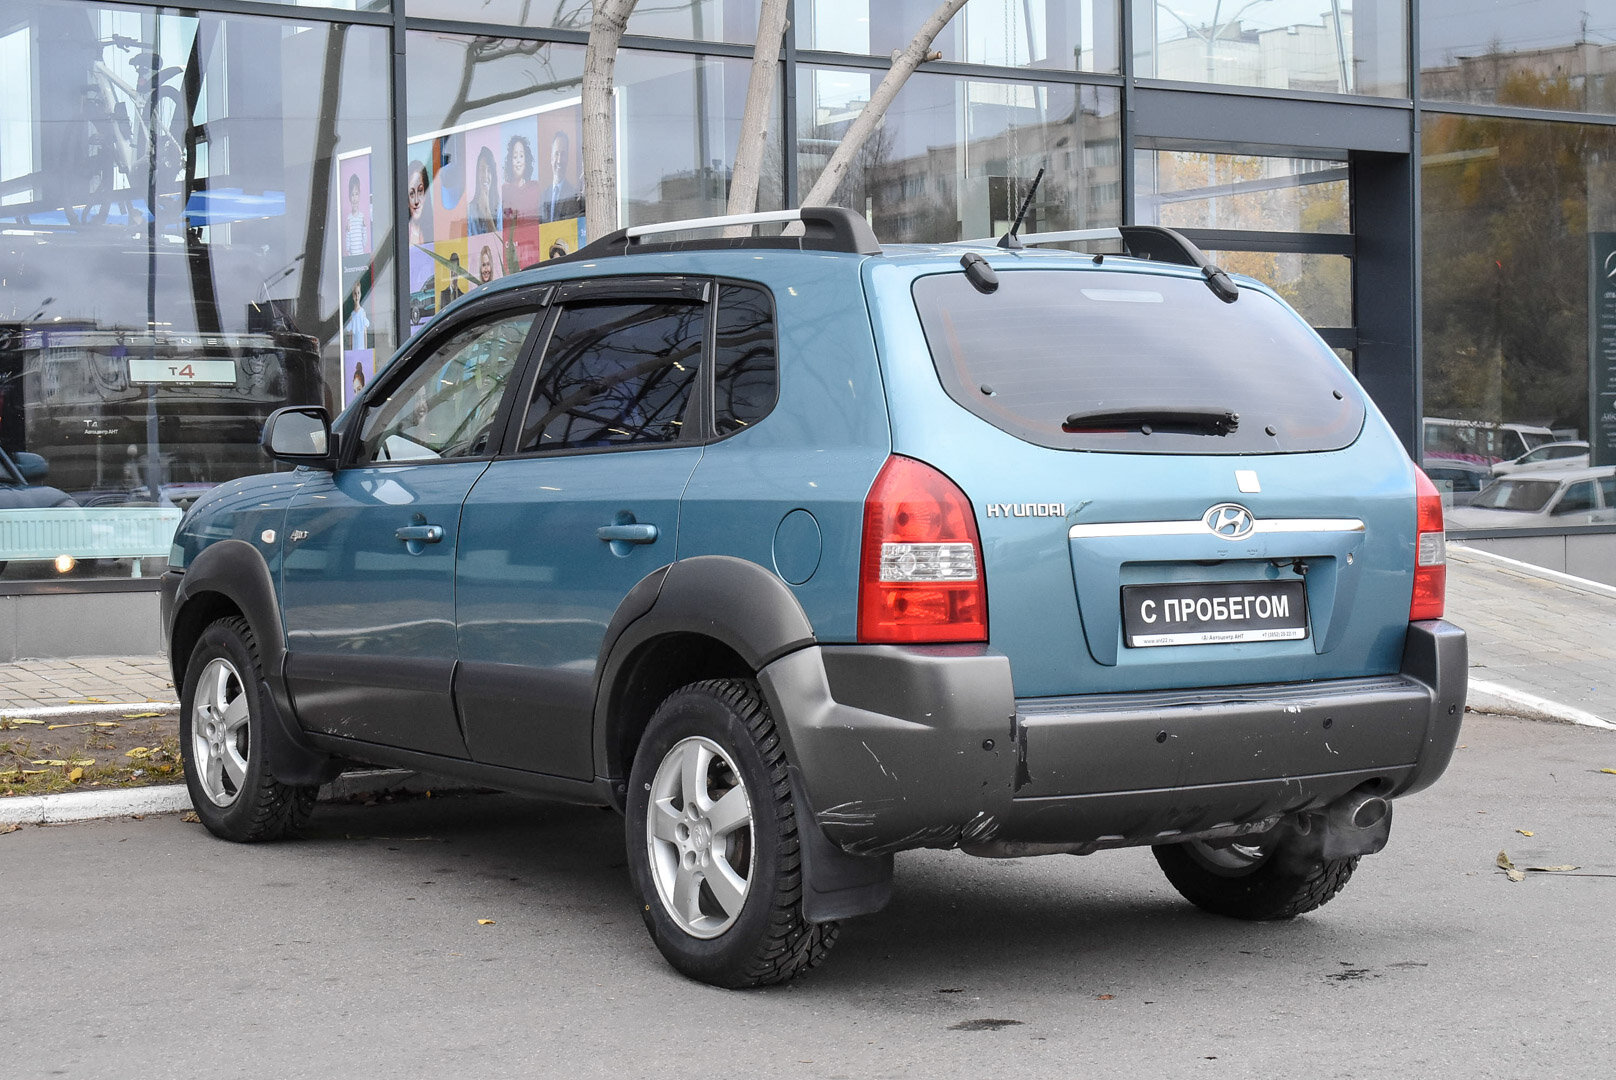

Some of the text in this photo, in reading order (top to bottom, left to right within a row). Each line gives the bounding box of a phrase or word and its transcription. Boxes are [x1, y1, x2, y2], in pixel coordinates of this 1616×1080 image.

[168, 364, 195, 379] T4
[985, 503, 1066, 518] HYUNDAI
[1140, 595, 1290, 624] С ПРОБЕГОМ
